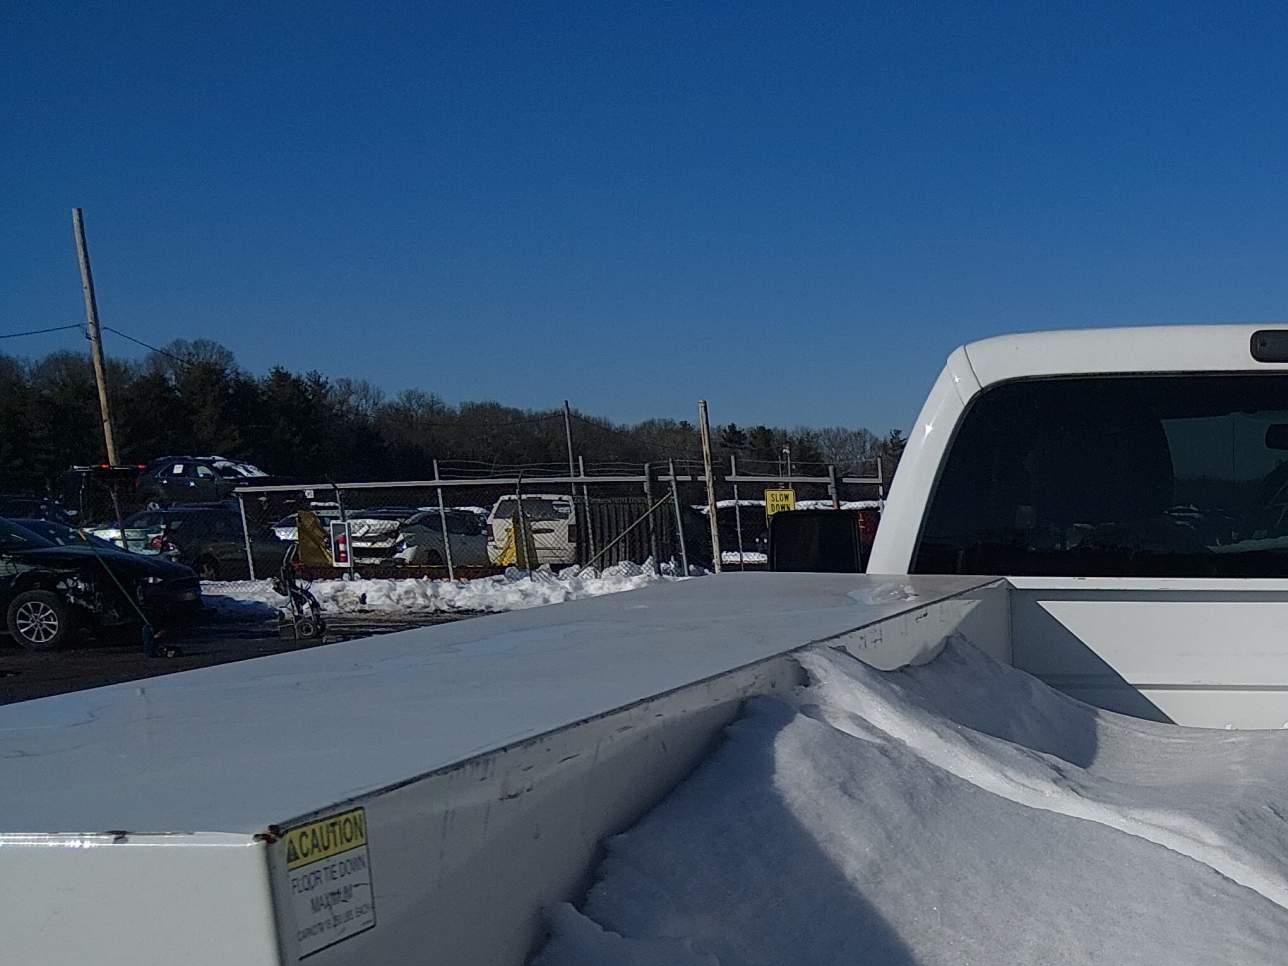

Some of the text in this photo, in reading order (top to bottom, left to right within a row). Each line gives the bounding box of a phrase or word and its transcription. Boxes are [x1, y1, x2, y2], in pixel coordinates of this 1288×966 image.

[770, 493, 790, 502] SLOW
[771, 503, 791, 513] DOWN
[298, 813, 364, 858] CAUTION
[322, 862, 339, 881] TIE
[338, 854, 367, 877] DOWN
